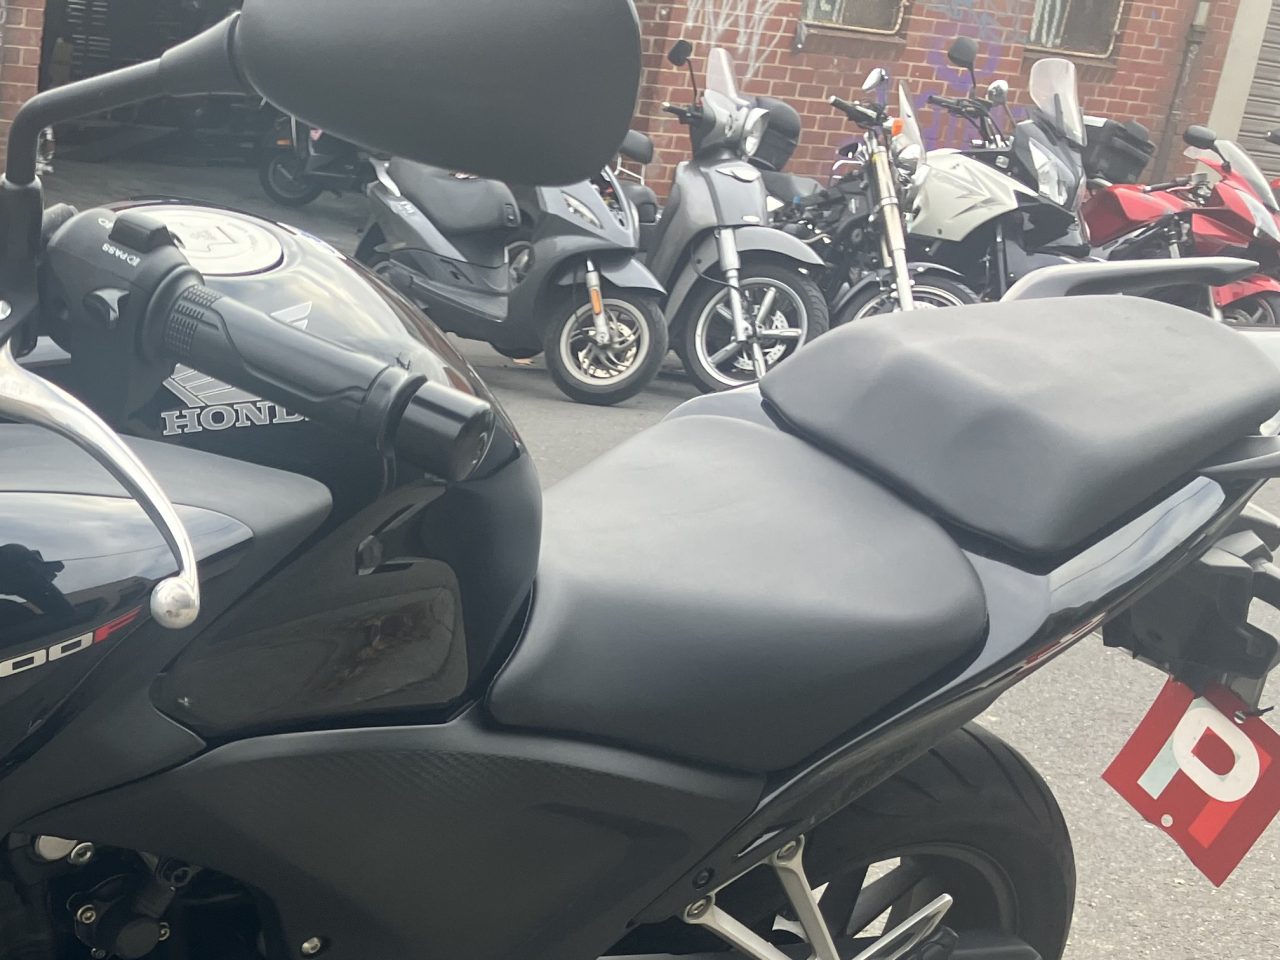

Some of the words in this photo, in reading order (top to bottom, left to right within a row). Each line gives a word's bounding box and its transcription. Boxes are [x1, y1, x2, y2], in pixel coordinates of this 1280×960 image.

[102, 243, 128, 260] PASS
[161, 401, 309, 435] HOND
[1136, 696, 1261, 802] P
